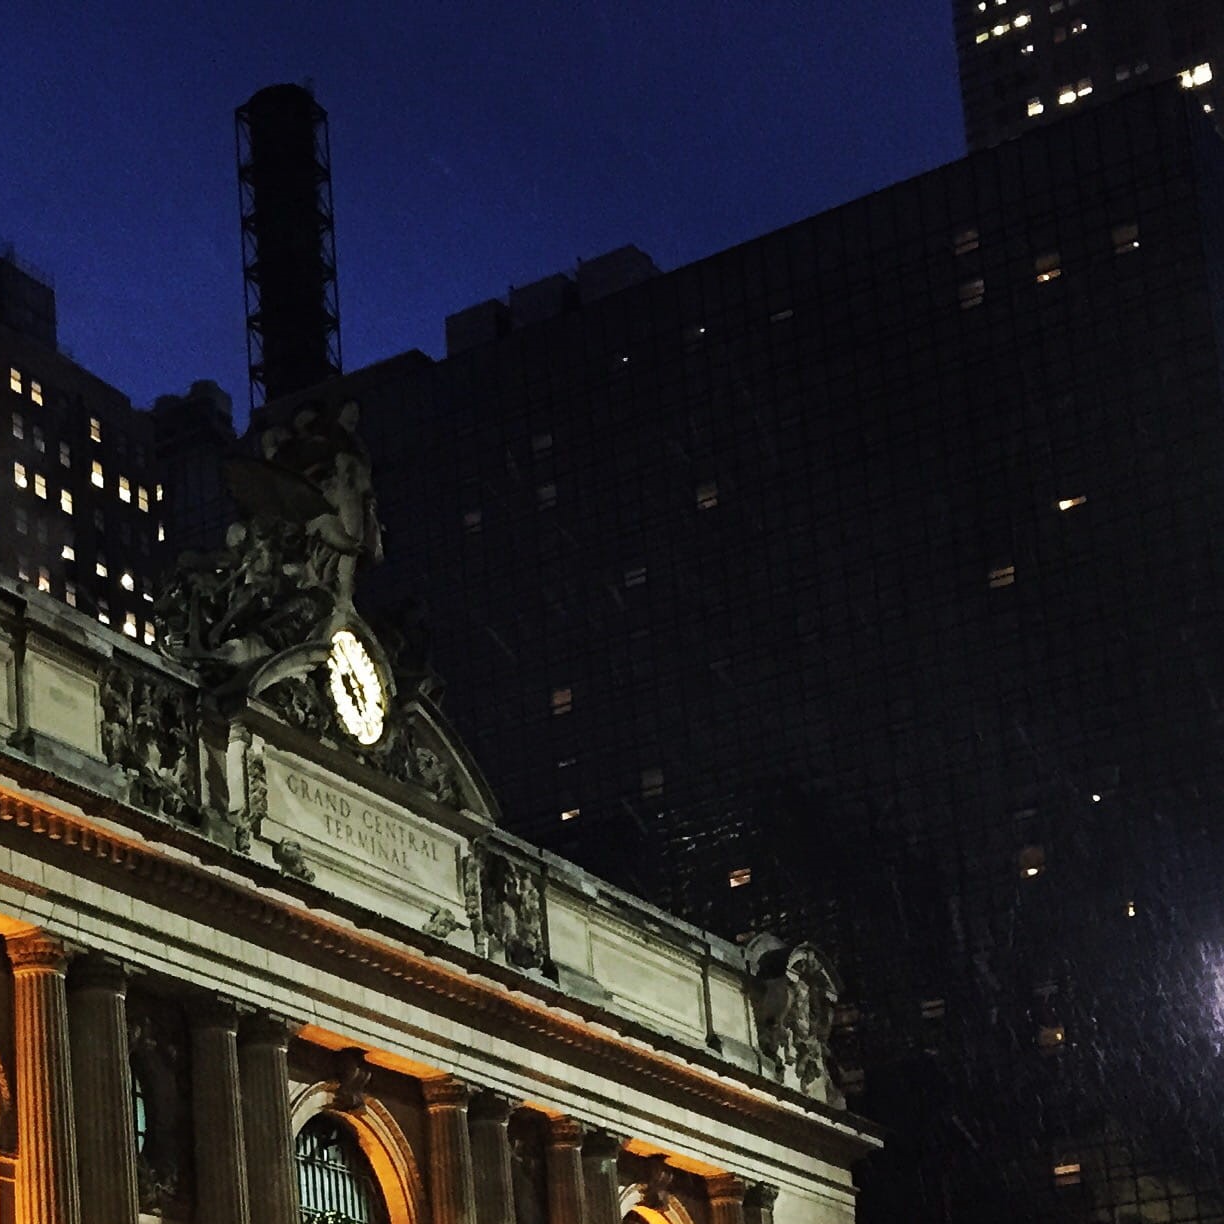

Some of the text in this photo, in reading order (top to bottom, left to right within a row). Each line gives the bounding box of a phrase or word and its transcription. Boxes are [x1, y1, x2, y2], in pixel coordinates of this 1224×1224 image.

[287, 774, 439, 862] GRAND CENTRAL
[323, 814, 410, 871] TERMINAL
